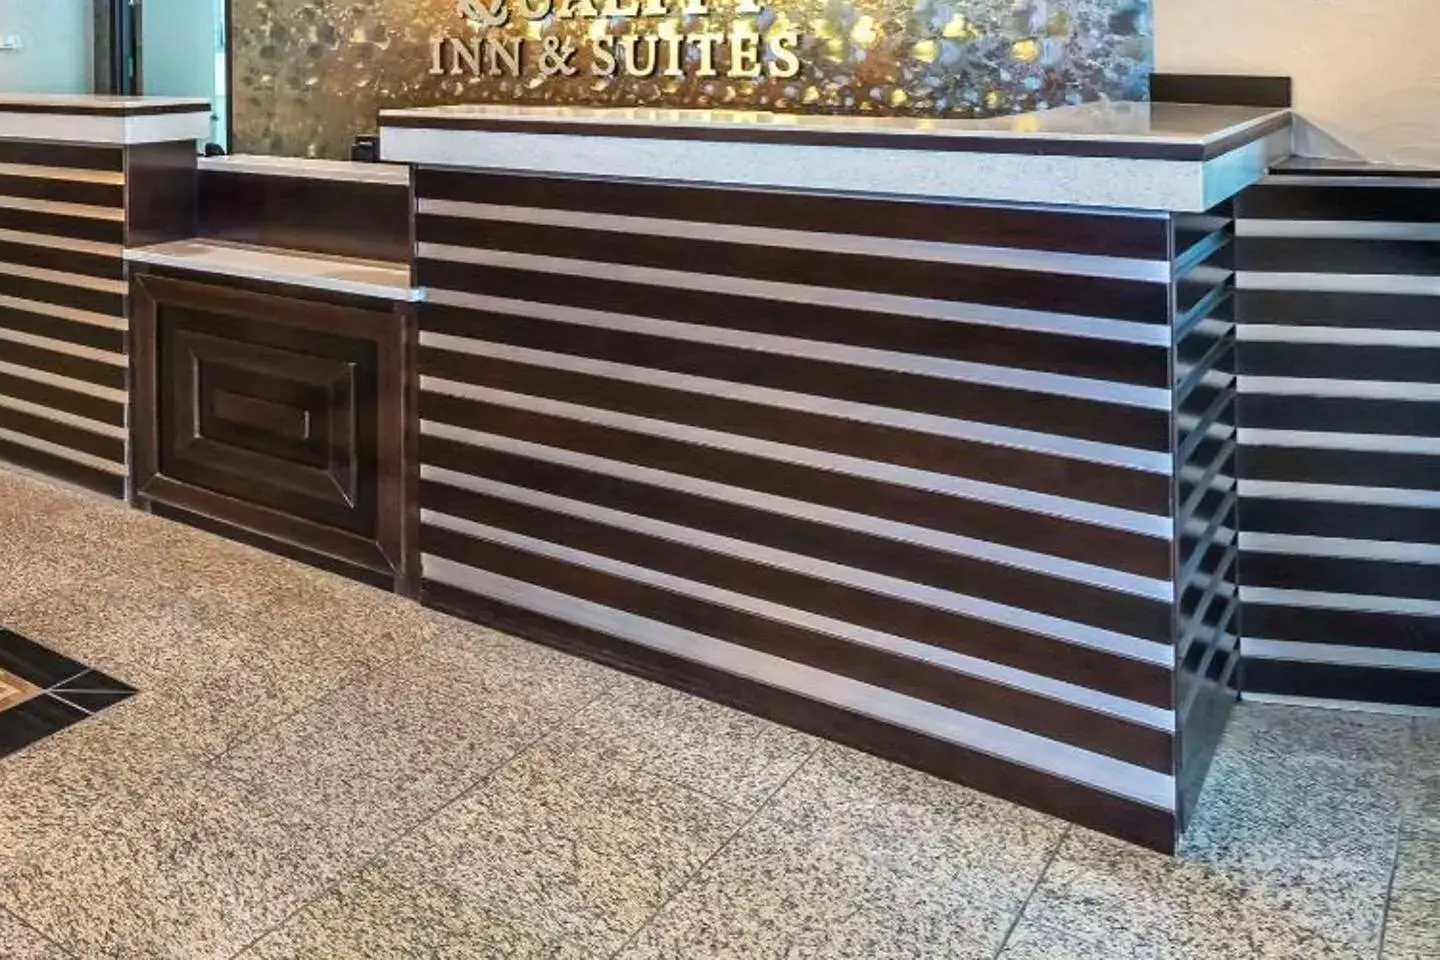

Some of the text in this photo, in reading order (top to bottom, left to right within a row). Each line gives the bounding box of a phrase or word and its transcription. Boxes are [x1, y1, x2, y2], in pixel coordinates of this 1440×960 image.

[428, 31, 800, 78] INN & SUITES
